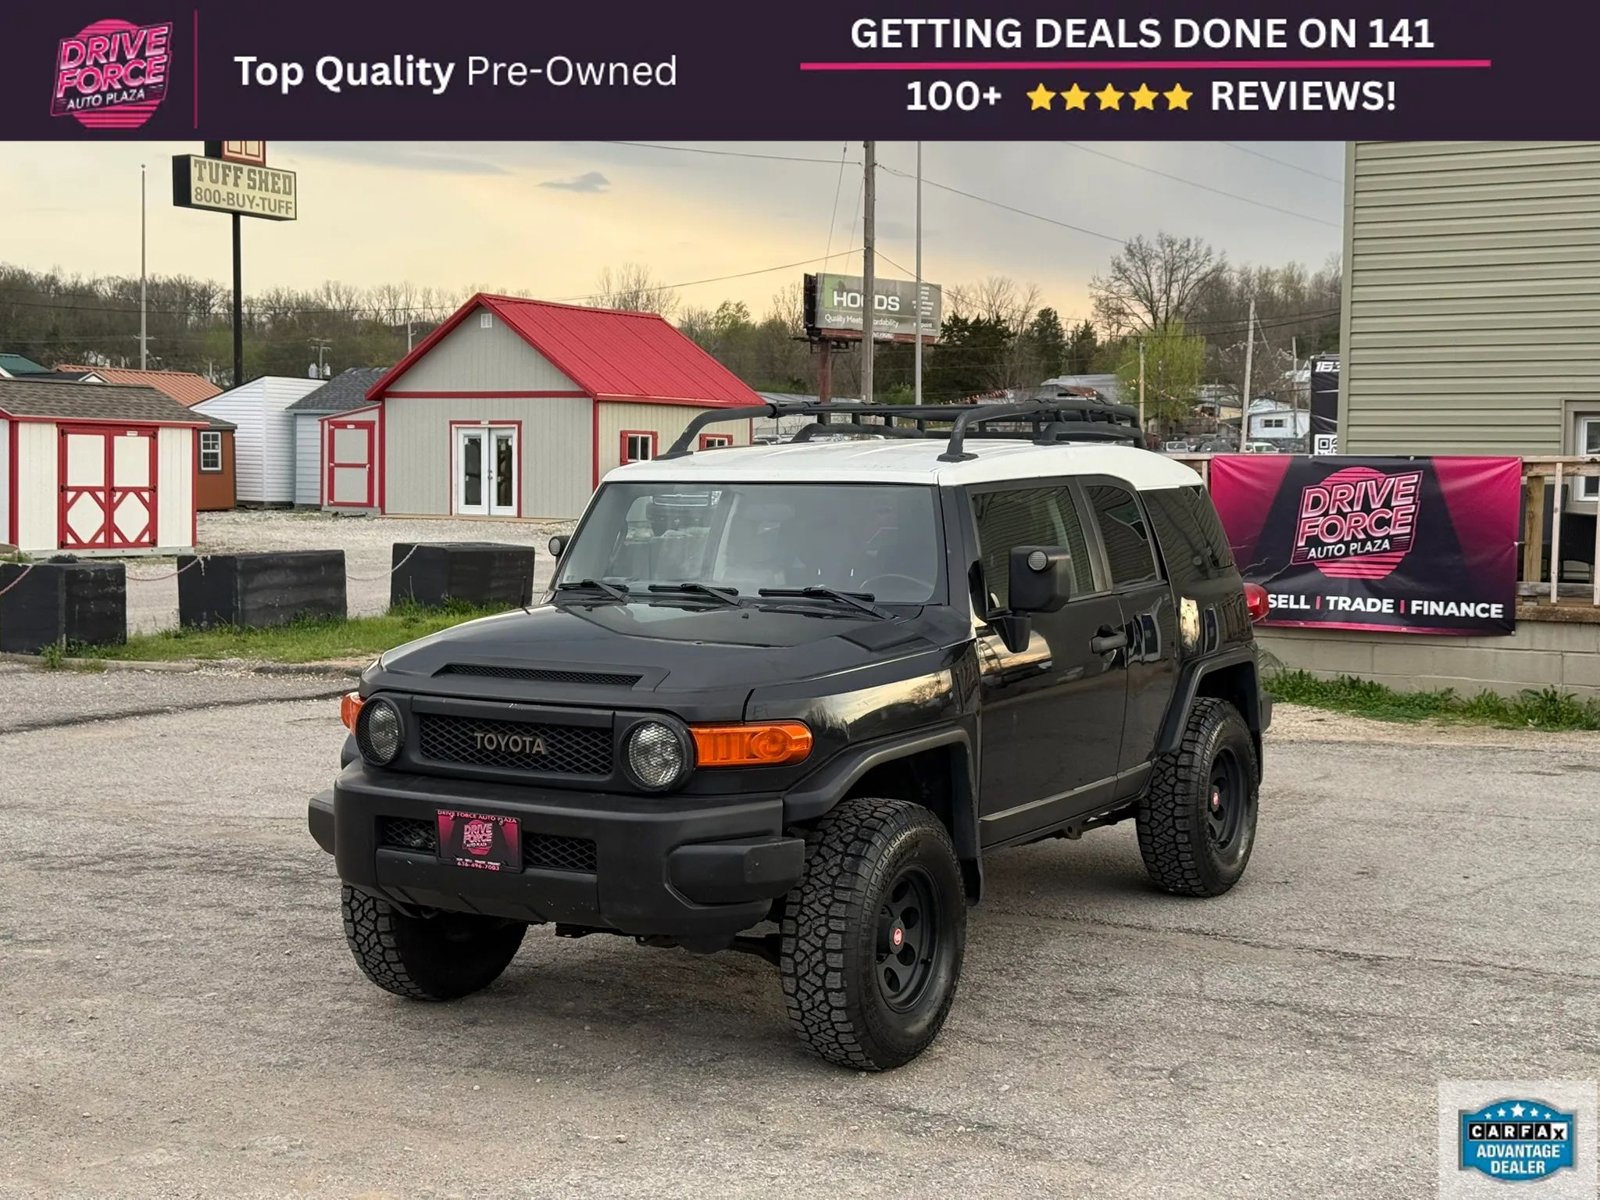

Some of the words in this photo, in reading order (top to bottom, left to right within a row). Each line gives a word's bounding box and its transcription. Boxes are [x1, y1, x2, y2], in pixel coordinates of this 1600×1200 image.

[193, 159, 244, 188] TUFF
[247, 168, 293, 196] SHED
[194, 186, 293, 215] 800-BUY-TUFF
[833, 290, 900, 312] HODS
[1301, 474, 1419, 518] DRIVE
[1297, 505, 1416, 547] FORCE
[1307, 543, 1346, 560] AUTO
[1349, 539, 1391, 556] PLAZA
[1267, 593, 1311, 610] SELL
[1325, 595, 1395, 614] TRADE
[1410, 600, 1504, 619] FINANCE
[474, 733, 546, 754] TOYOTA
[463, 823, 493, 836] DRIVE
[463, 832, 493, 844] FORCE
